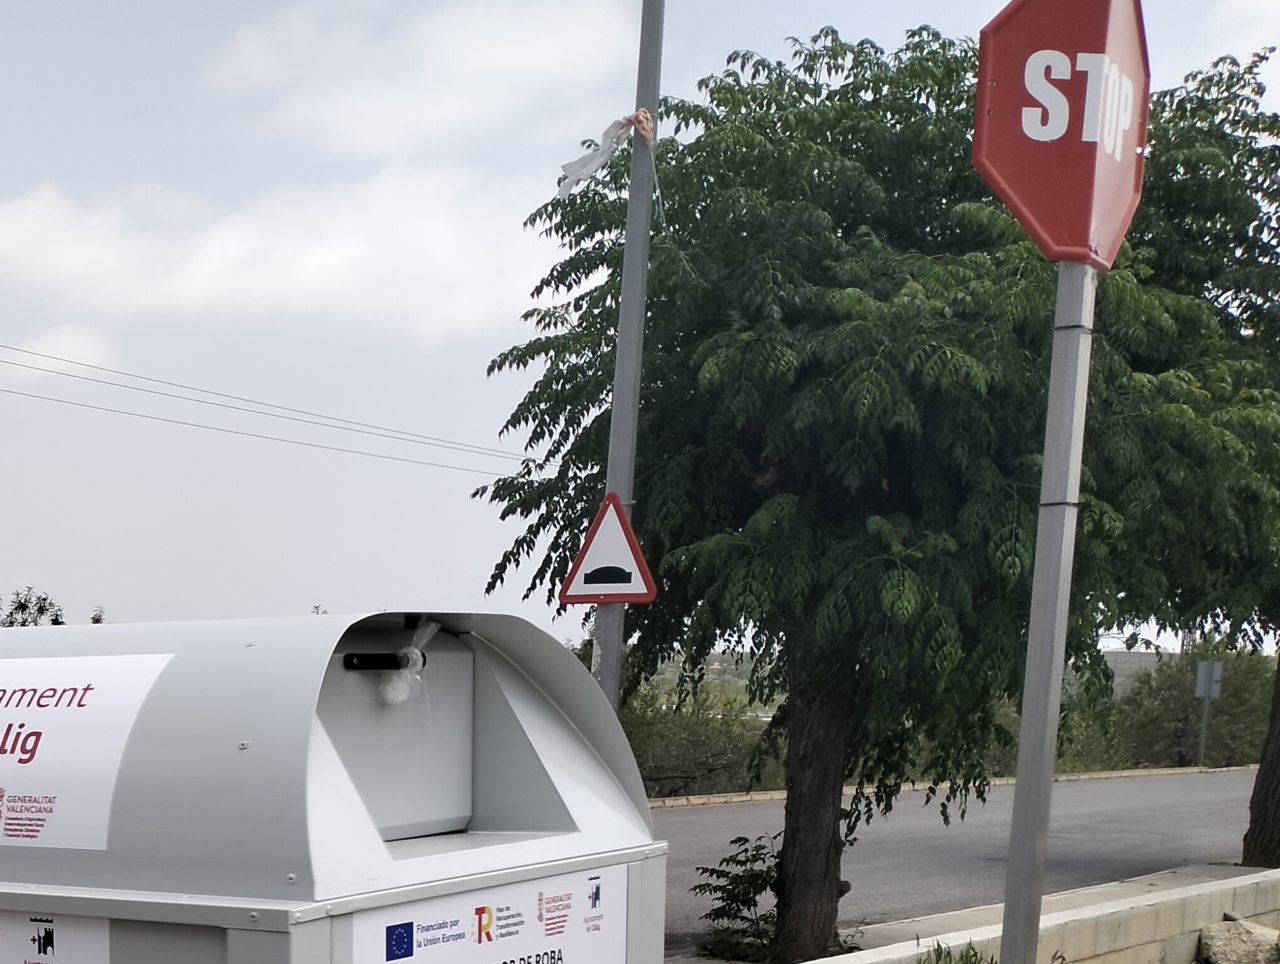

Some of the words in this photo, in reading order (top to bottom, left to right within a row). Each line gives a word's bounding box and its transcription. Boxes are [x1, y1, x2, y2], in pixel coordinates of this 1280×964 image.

[1021, 49, 1134, 162] STOP
[416, 920, 448, 934] Financiado
[450, 919, 460, 929] por
